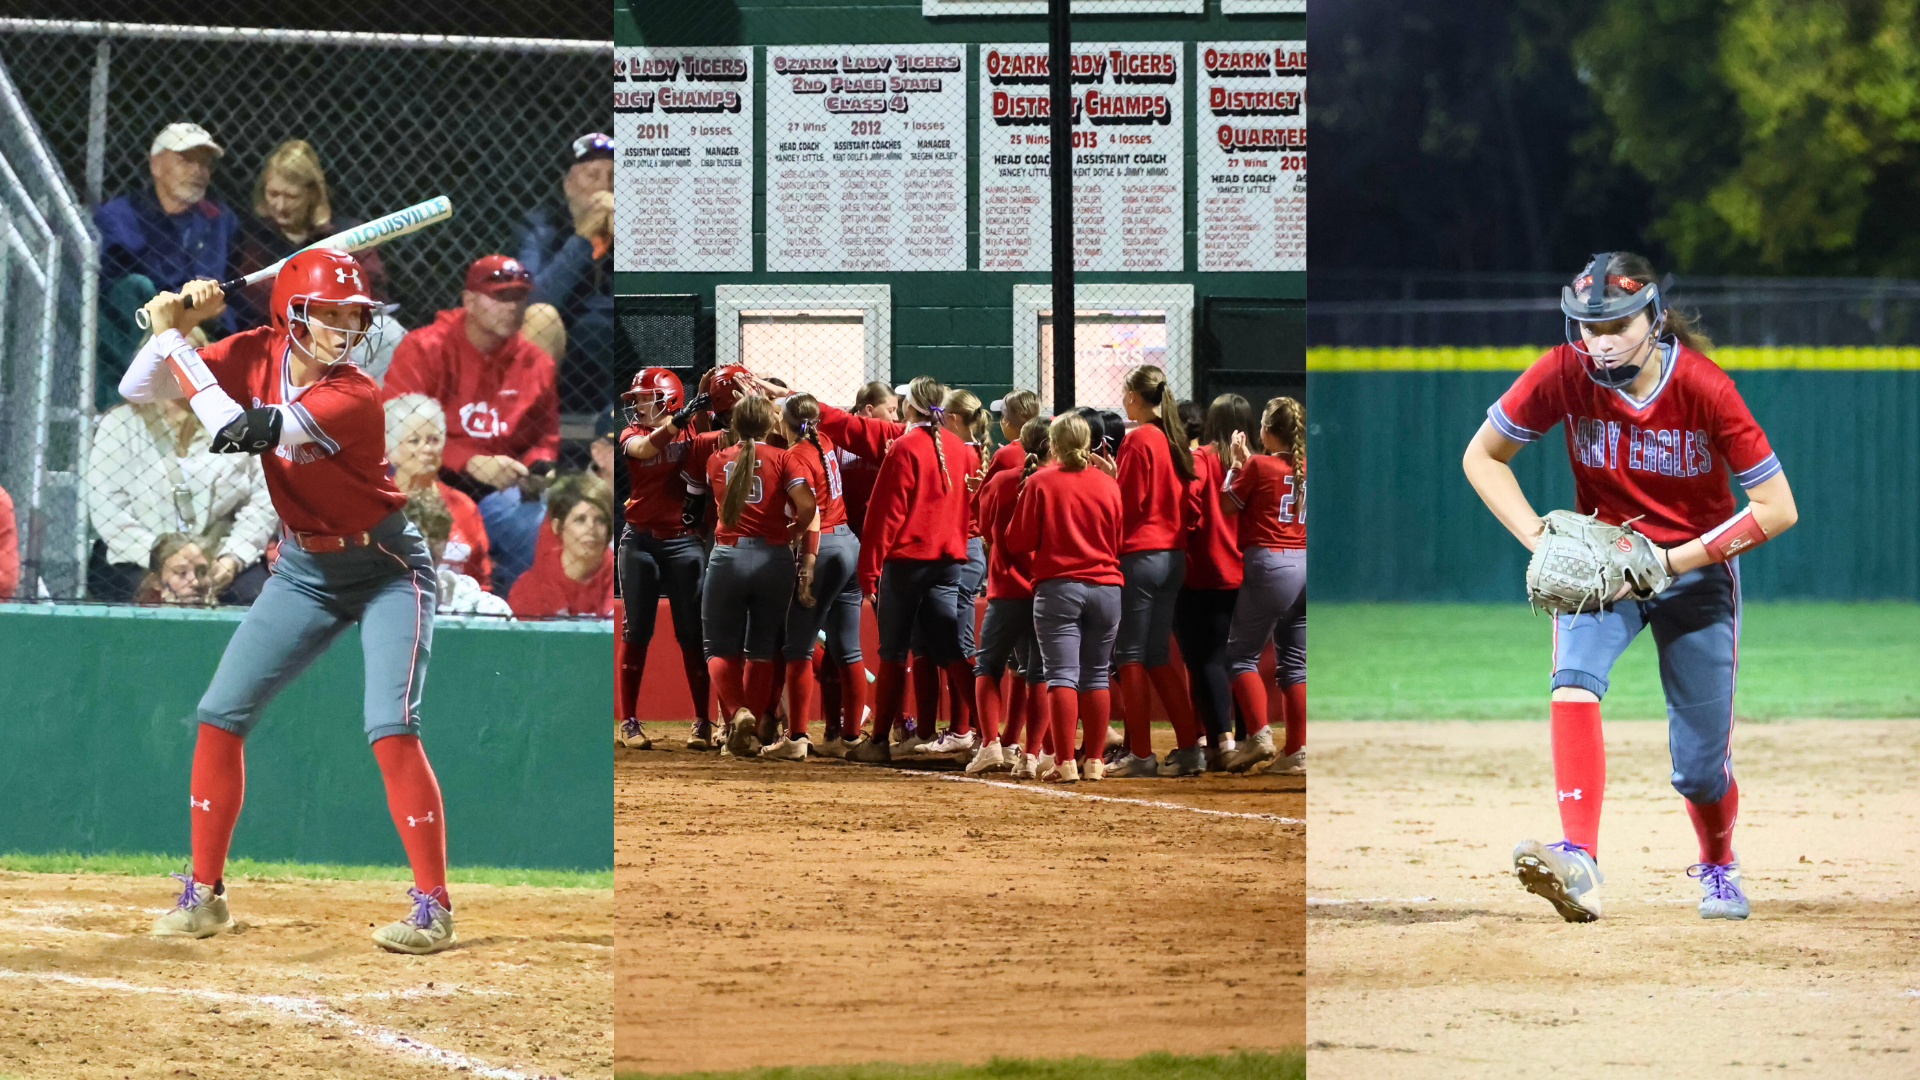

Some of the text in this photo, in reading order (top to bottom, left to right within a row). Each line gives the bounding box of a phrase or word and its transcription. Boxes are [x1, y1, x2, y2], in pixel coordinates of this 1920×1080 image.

[630, 55, 678, 78] LADY
[682, 55, 746, 79] TIGERS
[774, 55, 959, 72] OZARK LADY TIGERS
[987, 50, 1175, 80] OZARK ADY TIGERS
[1204, 48, 1271, 76] OZARK
[831, 77, 885, 92] PLACE
[890, 77, 940, 91] STATE
[658, 87, 739, 111] CHAMPS
[826, 96, 907, 112] CLASS 4
[1210, 87, 1299, 115] DISTRICT
[993, 89, 1170, 123] DISTRT CHAMPS
[637, 124, 669, 139] 2011
[691, 125, 732, 136] 9 losses
[788, 123, 799, 132] 27
[851, 121, 881, 135] 2012
[834, 140, 901, 150] ASSISTANT COACHES
[918, 140, 950, 149] MANAGER
[1011, 134, 1050, 144] 25 Wins
[1071, 131, 1097, 148] 013
[1110, 134, 1152, 144] 4 losses
[625, 148, 690, 156] ASSISTANT COACHES
[706, 147, 739, 156] MANAGER
[780, 142, 819, 151] HEAD COACH
[995, 155, 1050, 164] HEAD COAC
[1077, 153, 1166, 164] ASSISTANT COACH
[1228, 159, 1267, 168] 27 Wins
[1074, 168, 1090, 177] KENT
[1212, 175, 1276, 183] HEAD COACH
[353, 200, 447, 246] LOUISVILLE
[1629, 424, 1711, 477] EAGLES
